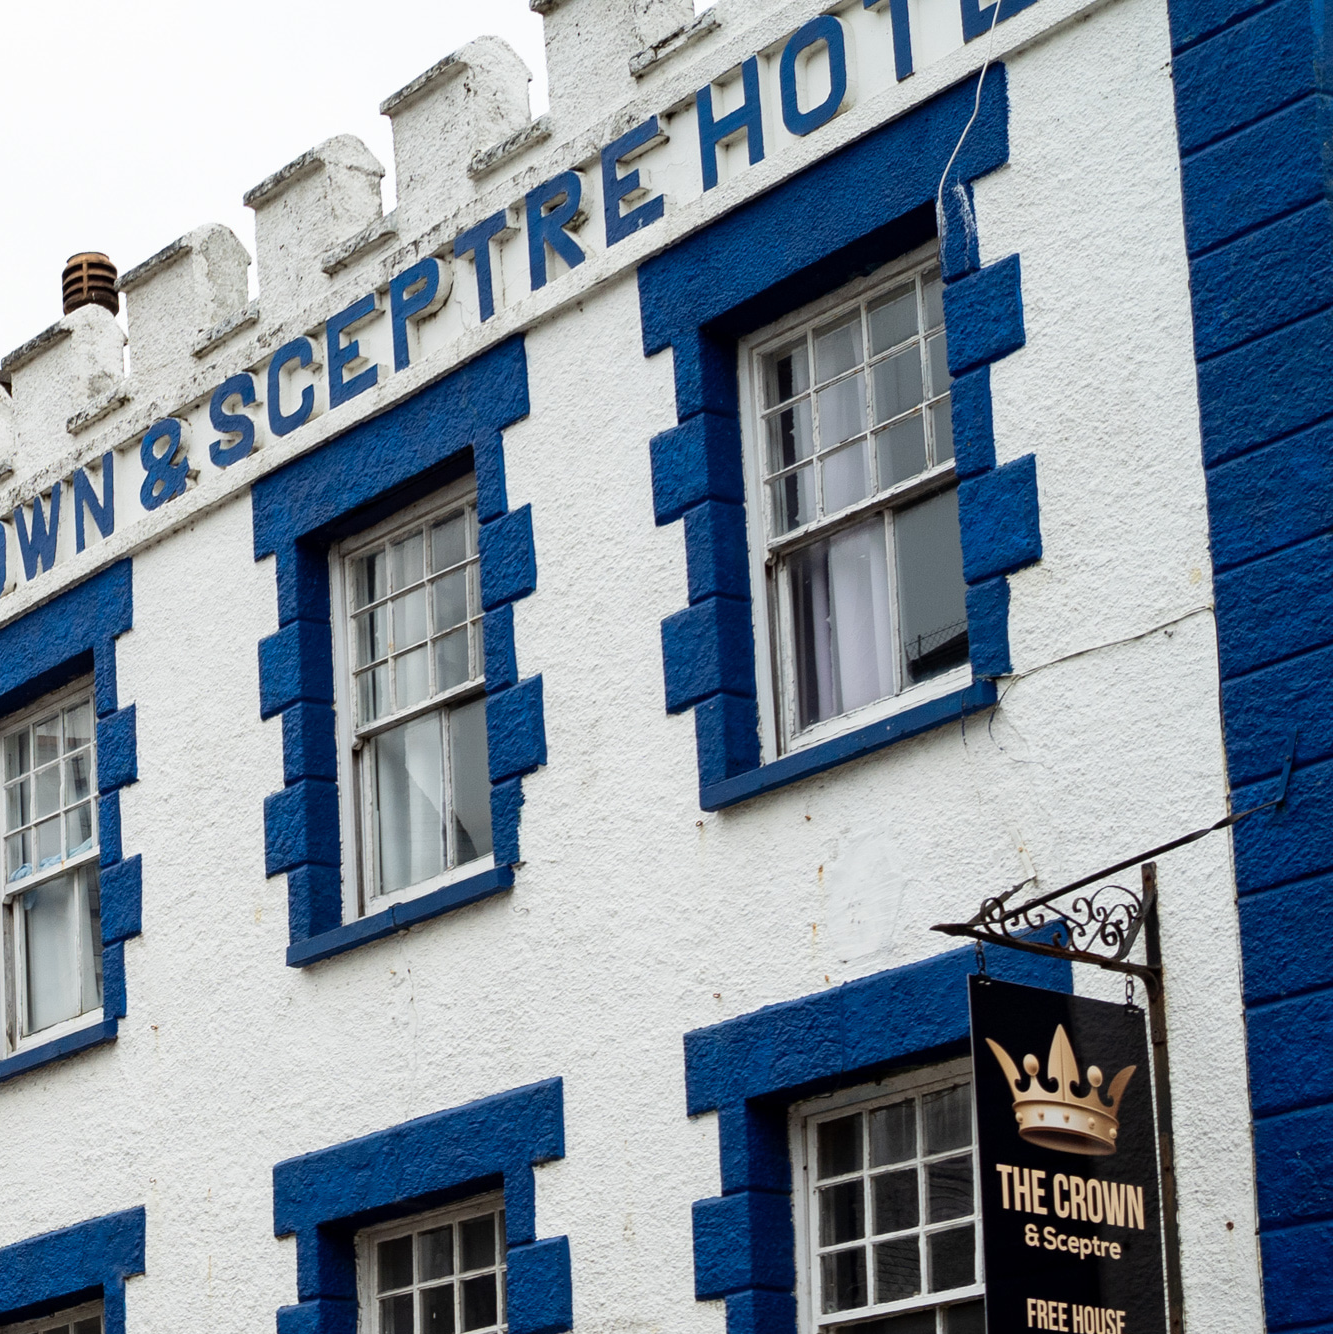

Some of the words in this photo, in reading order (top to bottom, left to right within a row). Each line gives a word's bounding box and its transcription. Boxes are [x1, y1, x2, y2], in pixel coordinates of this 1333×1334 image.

[140, 417, 190, 511] &
[209, 114, 665, 468] SCEPTRE
[996, 1163, 1048, 1215] THE
[1053, 1173, 1145, 1230] CROWN
[1024, 1223, 1040, 1247] &
[1043, 1225, 1122, 1260] Sceptre
[1027, 1298, 1069, 1333] FREE
